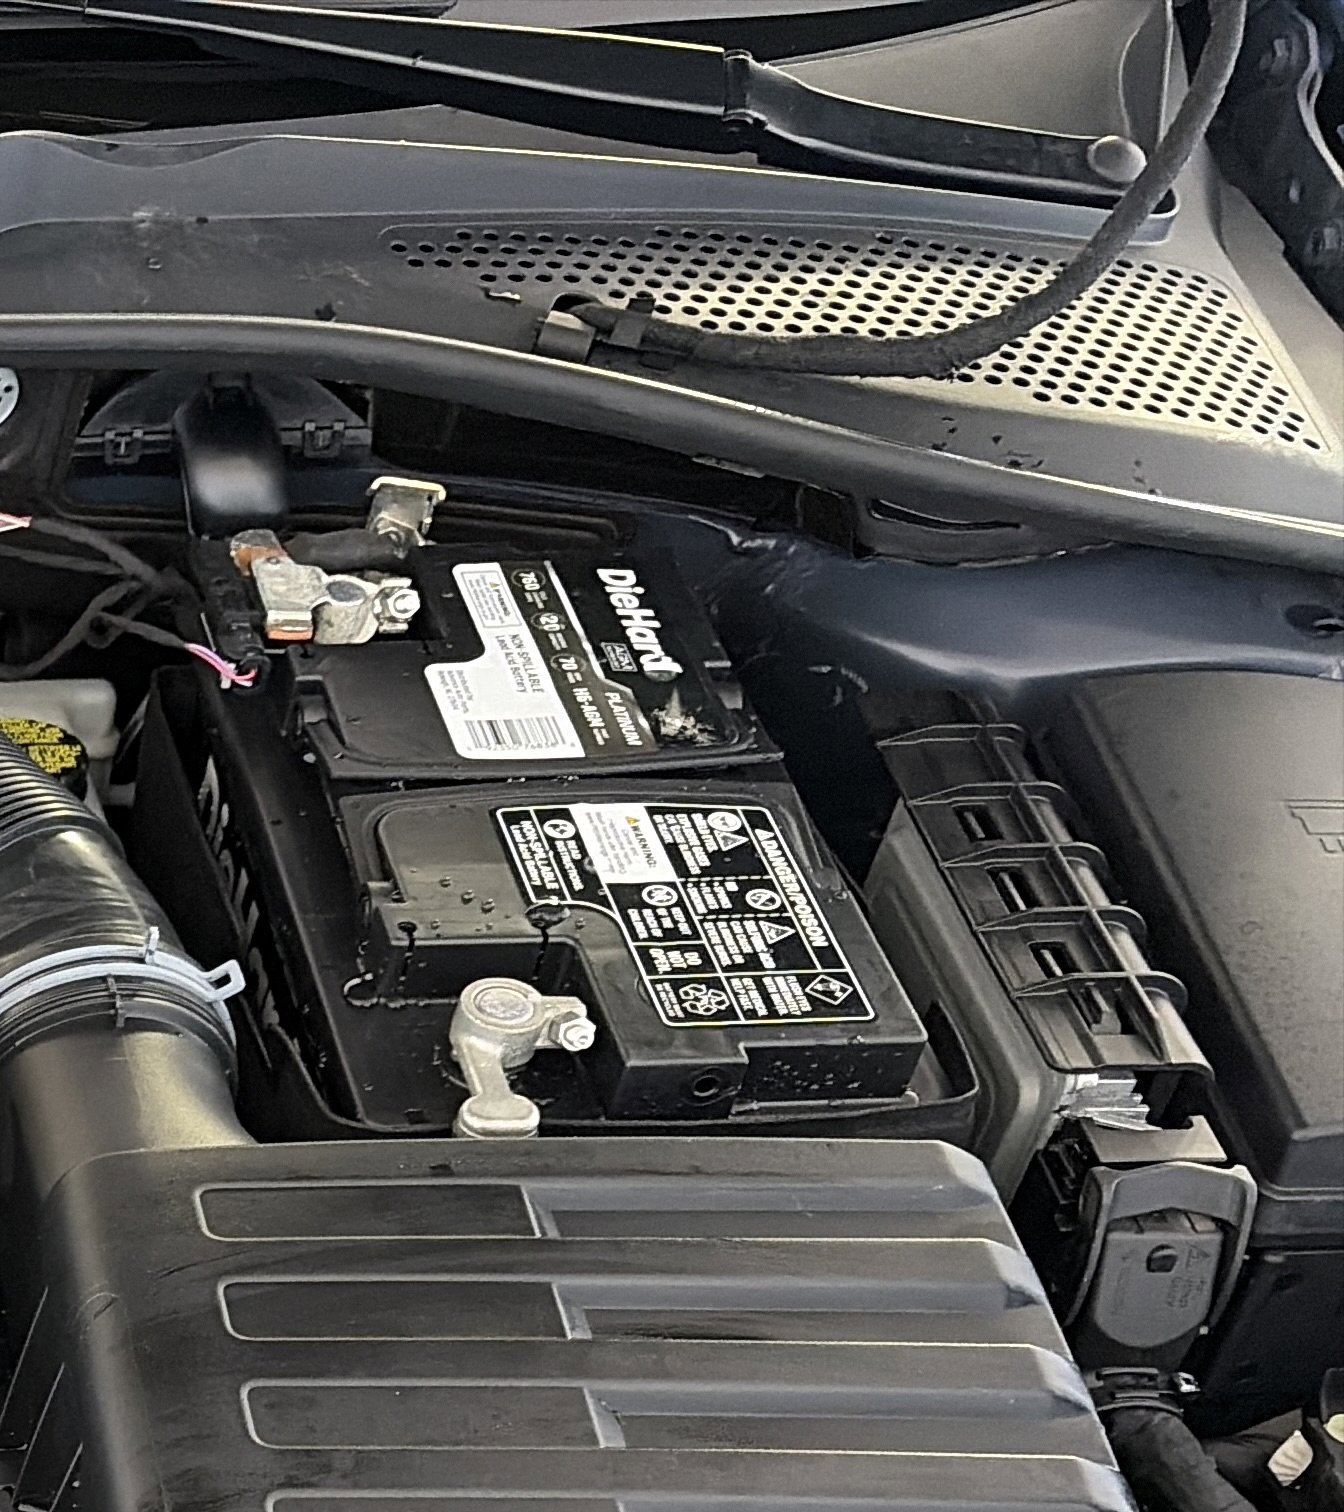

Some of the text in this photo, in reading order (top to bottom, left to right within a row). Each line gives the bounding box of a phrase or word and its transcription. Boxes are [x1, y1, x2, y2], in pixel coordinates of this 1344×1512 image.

[596, 569, 683, 673] DieHard
[510, 634, 544, 693] NON-SPILLABLE
[511, 667, 527, 693] Battery
[605, 692, 642, 746] PLATINUM
[520, 820, 559, 890] NON-SPILLABLE
[631, 826, 657, 868] WARNING:
[762, 841, 829, 947] DANGER/POISON
